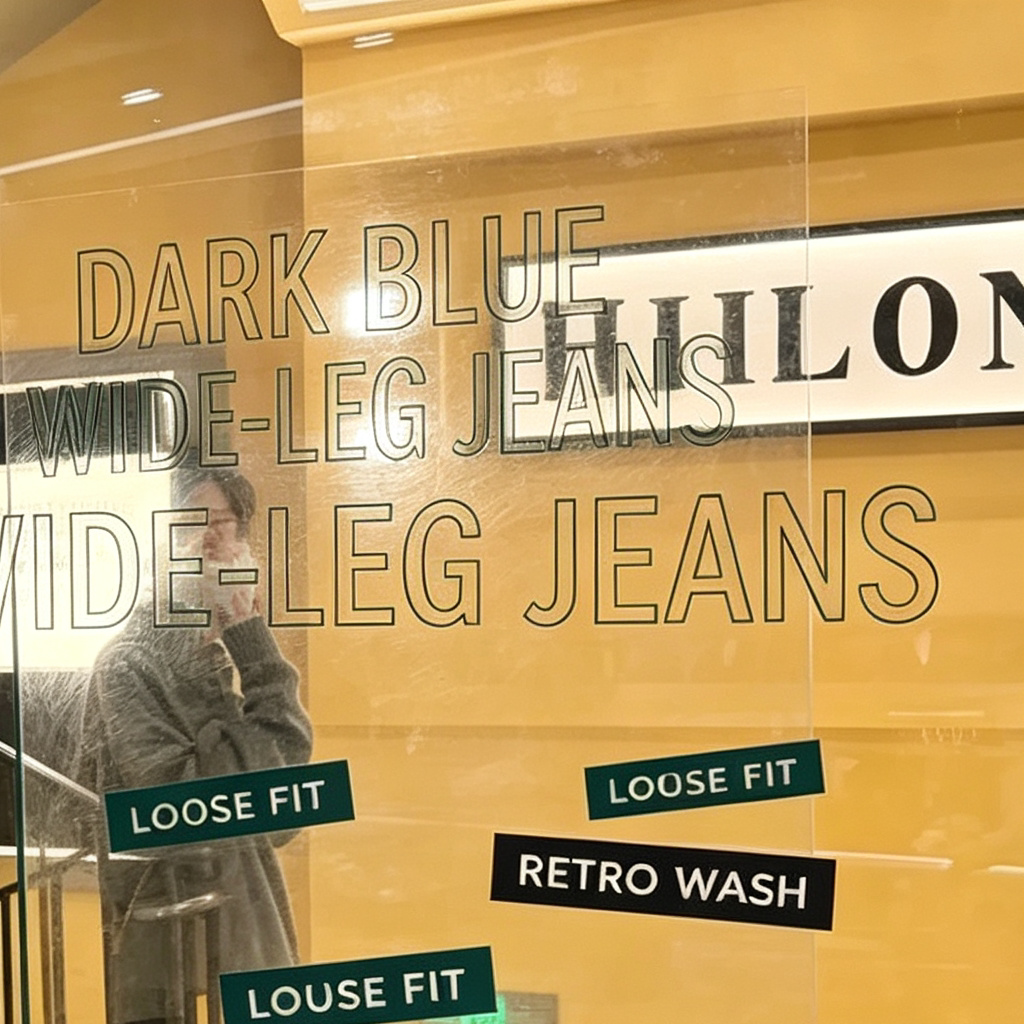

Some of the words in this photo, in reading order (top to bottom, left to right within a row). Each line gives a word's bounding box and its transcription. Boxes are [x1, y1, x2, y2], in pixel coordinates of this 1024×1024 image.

[77, 228, 330, 354] DARK
[364, 205, 605, 332] BLUE
[26, 356, 426, 478] WIDE-LEG
[452, 334, 735, 457] JEANS
[523, 485, 939, 627] JEANS
[130, 794, 255, 835] LOOSE
[269, 780, 325, 816] FIT
[609, 767, 728, 804] LOOSE
[743, 758, 797, 790] FIT
[519, 853, 659, 897] RETRO
[675, 866, 808, 910] WASH
[248, 976, 387, 1020] LOUSE
[402, 968, 465, 1005] FIT
